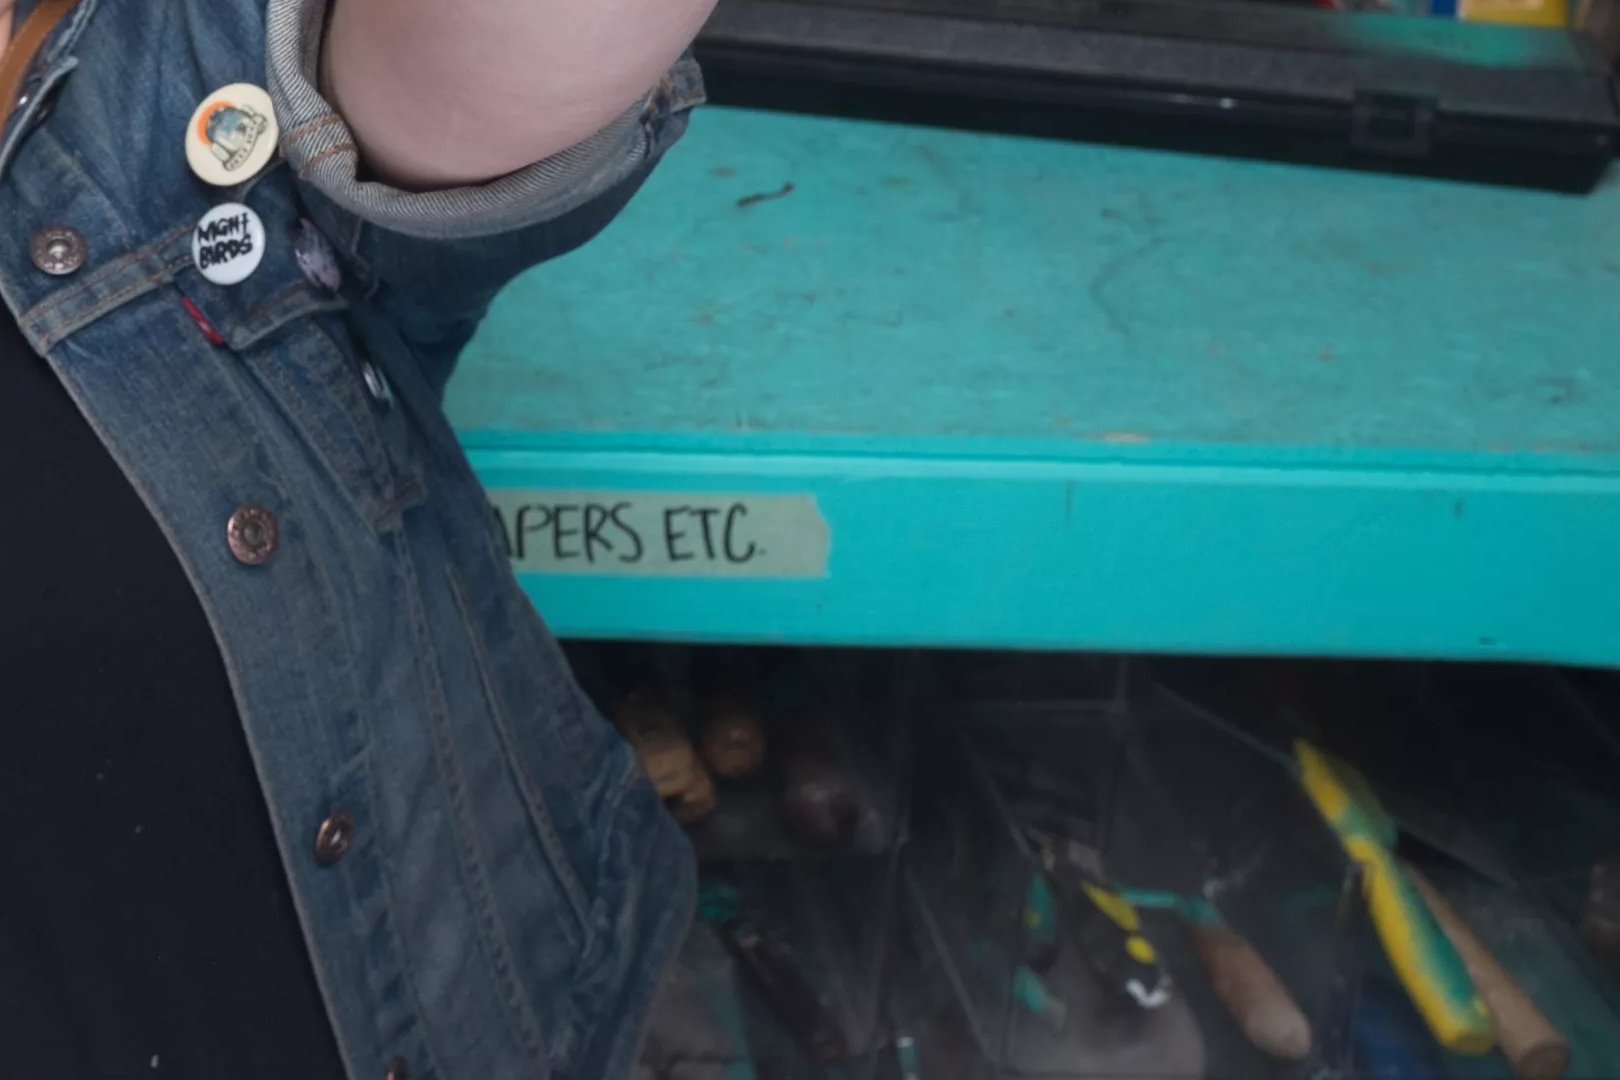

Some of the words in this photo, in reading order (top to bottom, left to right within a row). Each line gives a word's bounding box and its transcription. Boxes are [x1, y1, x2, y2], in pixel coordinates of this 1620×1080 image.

[197, 212, 250, 244] NIGHT
[198, 233, 254, 270] BIRDS
[663, 502, 768, 565] ETC.
